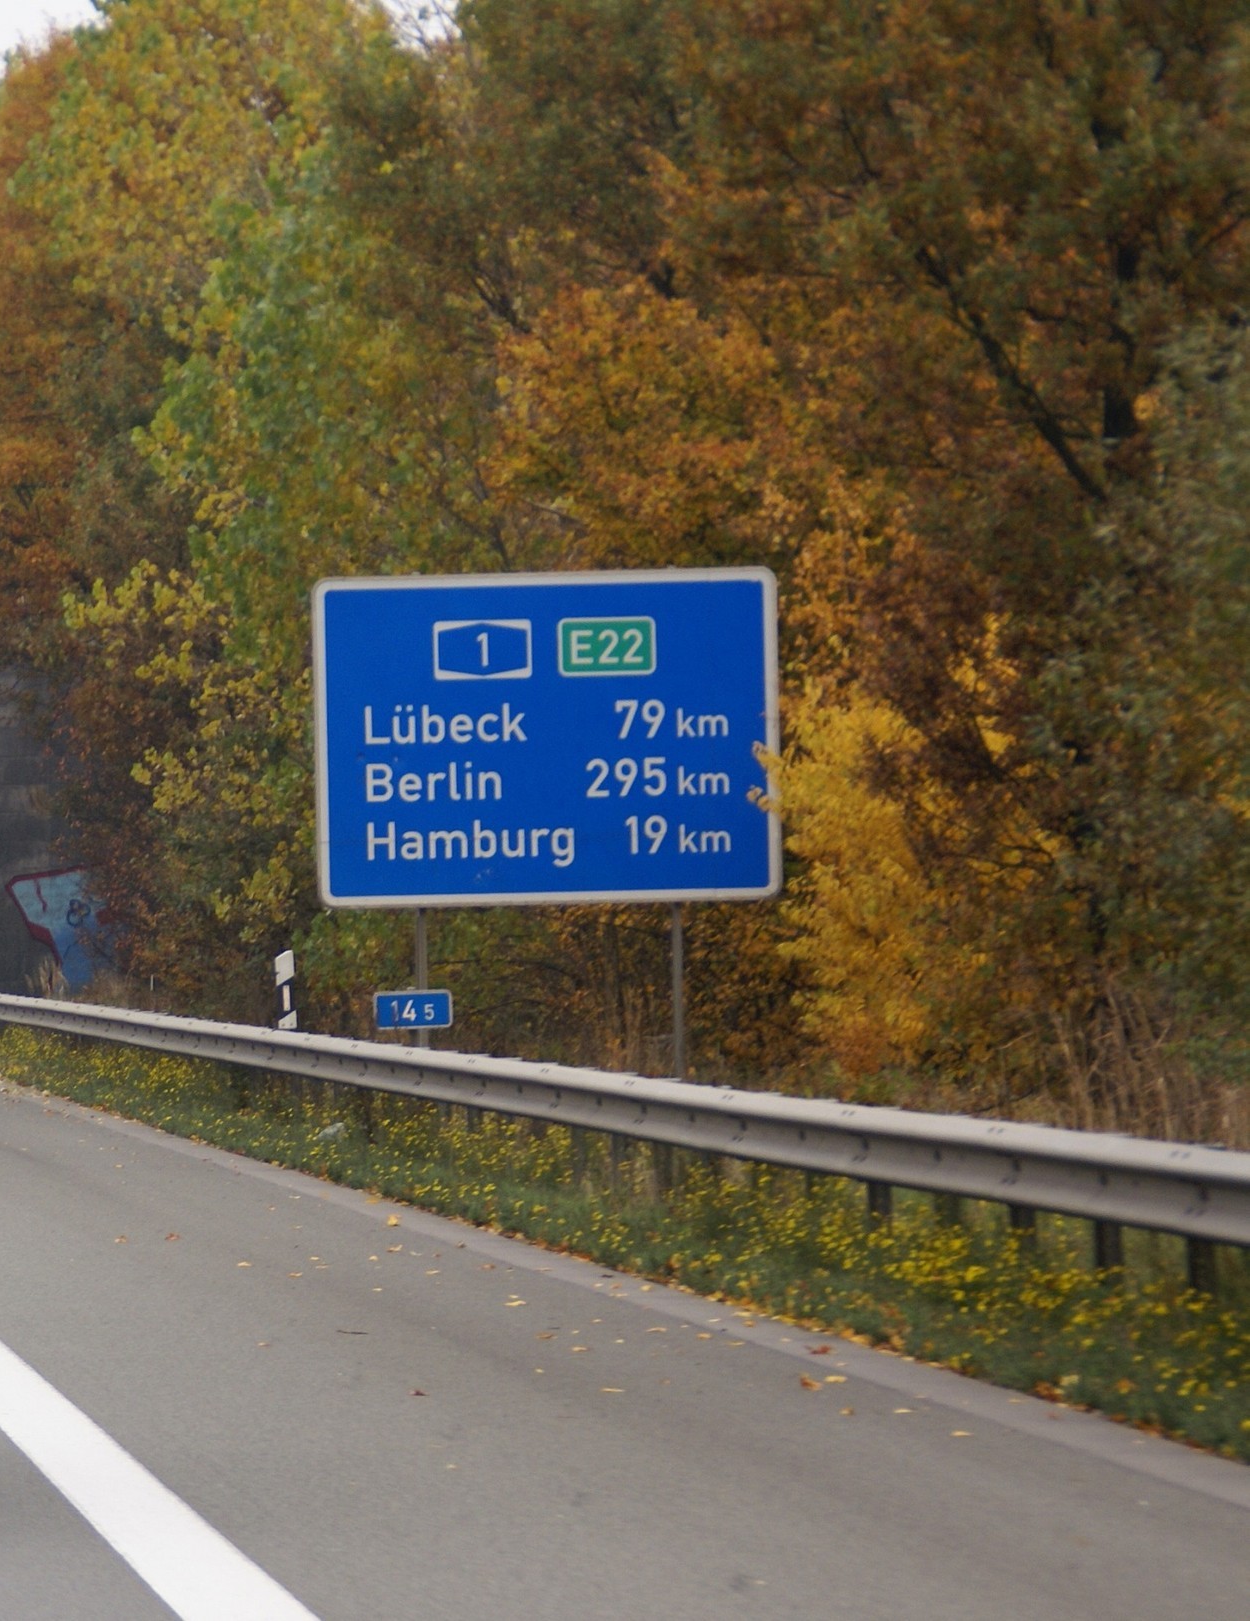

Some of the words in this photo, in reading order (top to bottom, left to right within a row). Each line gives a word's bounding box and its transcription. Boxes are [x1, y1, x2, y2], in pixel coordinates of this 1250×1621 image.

[476, 632, 489, 668] 1
[569, 629, 644, 665] E22
[363, 703, 527, 745] Lübeck
[615, 699, 665, 740] 79
[676, 708, 729, 738] km
[365, 761, 503, 802] Berlin
[586, 756, 667, 798] 295
[678, 765, 731, 795] km
[366, 819, 576, 868] Hamburg
[624, 815, 668, 855] 19
[679, 823, 732, 854] km
